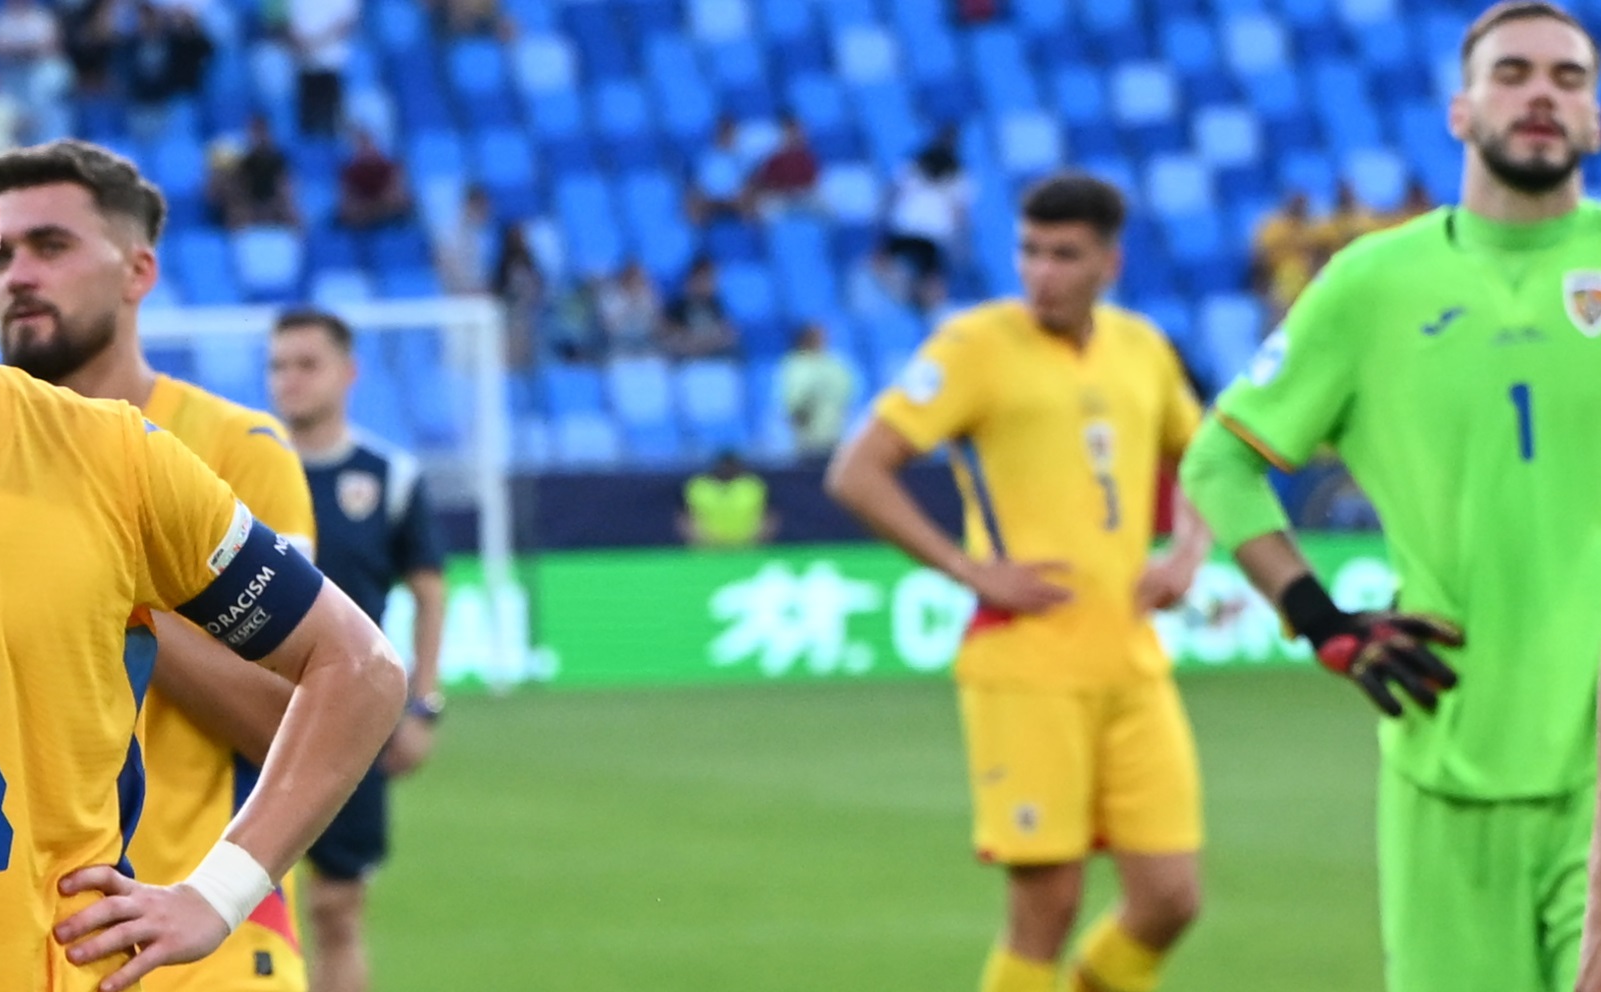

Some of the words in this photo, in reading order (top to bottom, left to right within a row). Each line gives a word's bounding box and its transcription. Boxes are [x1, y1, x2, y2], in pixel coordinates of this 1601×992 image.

[1508, 382, 1536, 464] 1
[218, 565, 276, 628] RACISM
[228, 608, 267, 645] RESPECT
